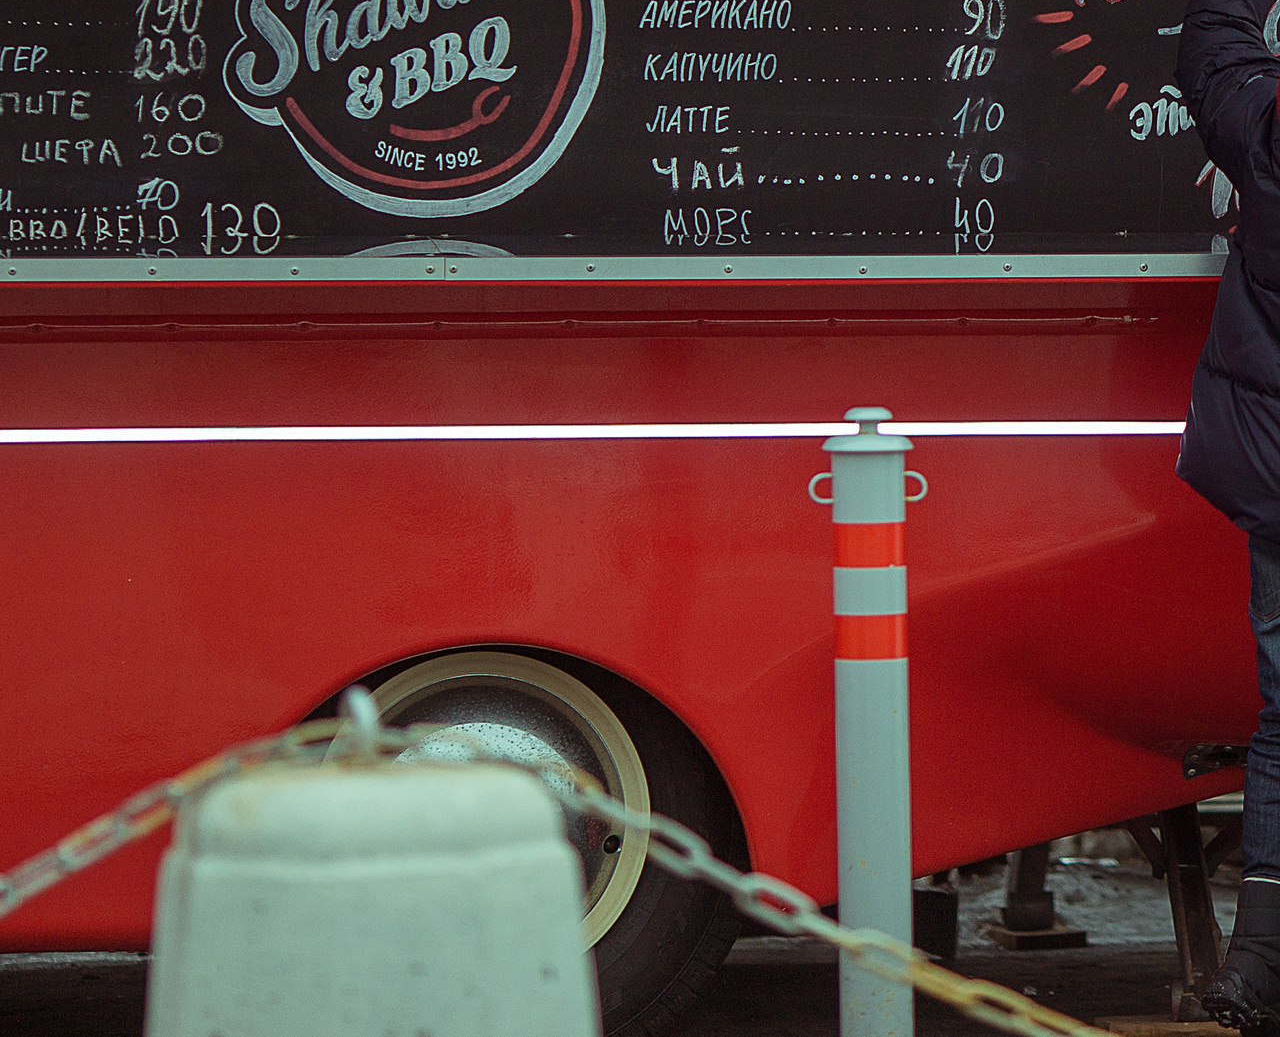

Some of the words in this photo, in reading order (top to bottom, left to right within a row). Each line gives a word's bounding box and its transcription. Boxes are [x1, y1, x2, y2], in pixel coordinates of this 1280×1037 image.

[134, 34, 207, 82] 220
[390, 16, 518, 109] BBQ
[643, 51, 778, 83] КАПУЧИНО
[945, 44, 997, 81] 110
[134, 91, 206, 123] 160
[646, 105, 730, 134] ЛАТТЕ
[951, 96, 1006, 140] 110
[21, 138, 123, 168] ШЕФА
[140, 130, 224, 160] 200
[374, 140, 426, 172] SINCE
[435, 146, 483, 171] 1992
[652, 146, 745, 191] ЧАЙ
[946, 149, 1005, 188] 40
[136, 177, 180, 211] 70
